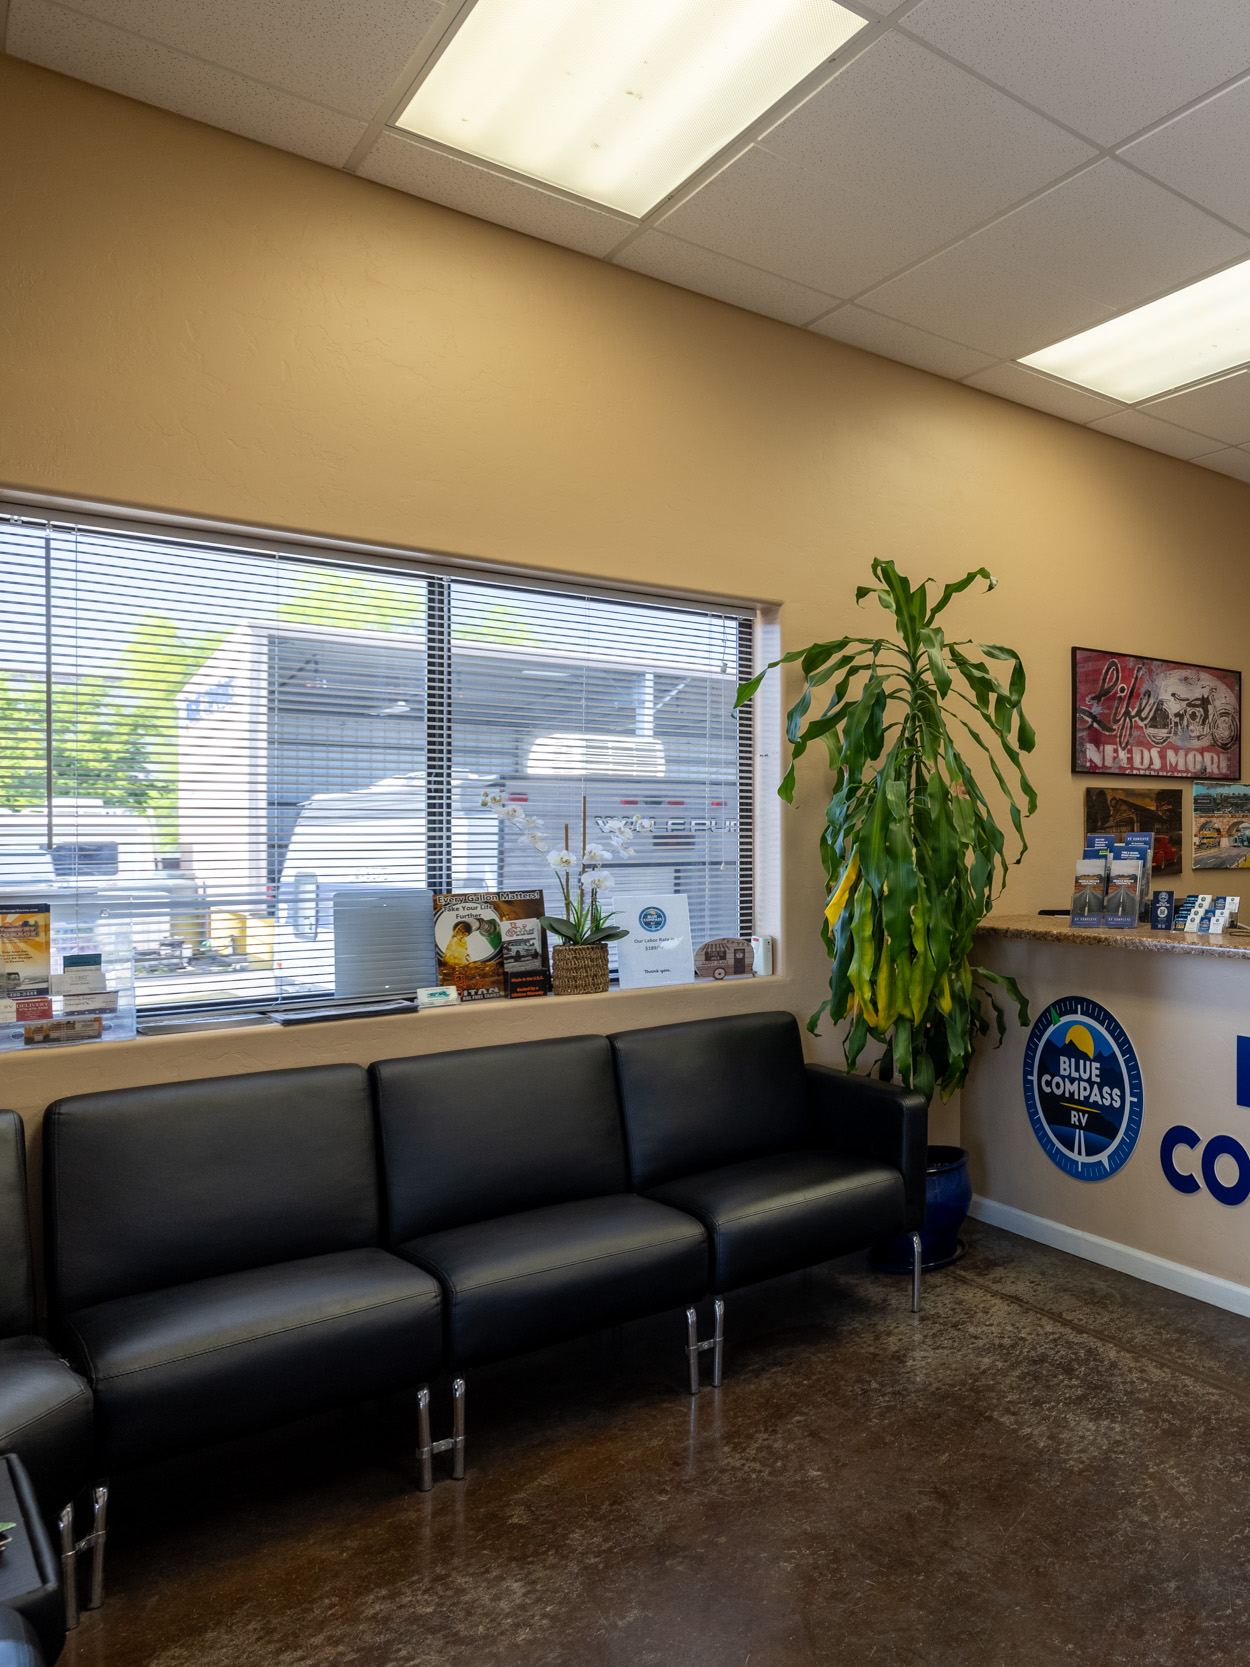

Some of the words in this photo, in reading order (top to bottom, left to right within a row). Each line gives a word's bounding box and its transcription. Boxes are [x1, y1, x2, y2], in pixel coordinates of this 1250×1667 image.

[1077, 659, 1158, 751] Life
[1085, 743, 1162, 770] NEEDS
[1166, 748, 1231, 775] MORE
[437, 895, 465, 905] Every
[466, 893, 499, 903] Gallon
[500, 890, 540, 900] Matters!
[462, 987, 500, 996] ITAN
[1059, 1055, 1101, 1082] BLUE
[1041, 1074, 1122, 1109] COMPASS
[1070, 1110, 1089, 1127] RV
